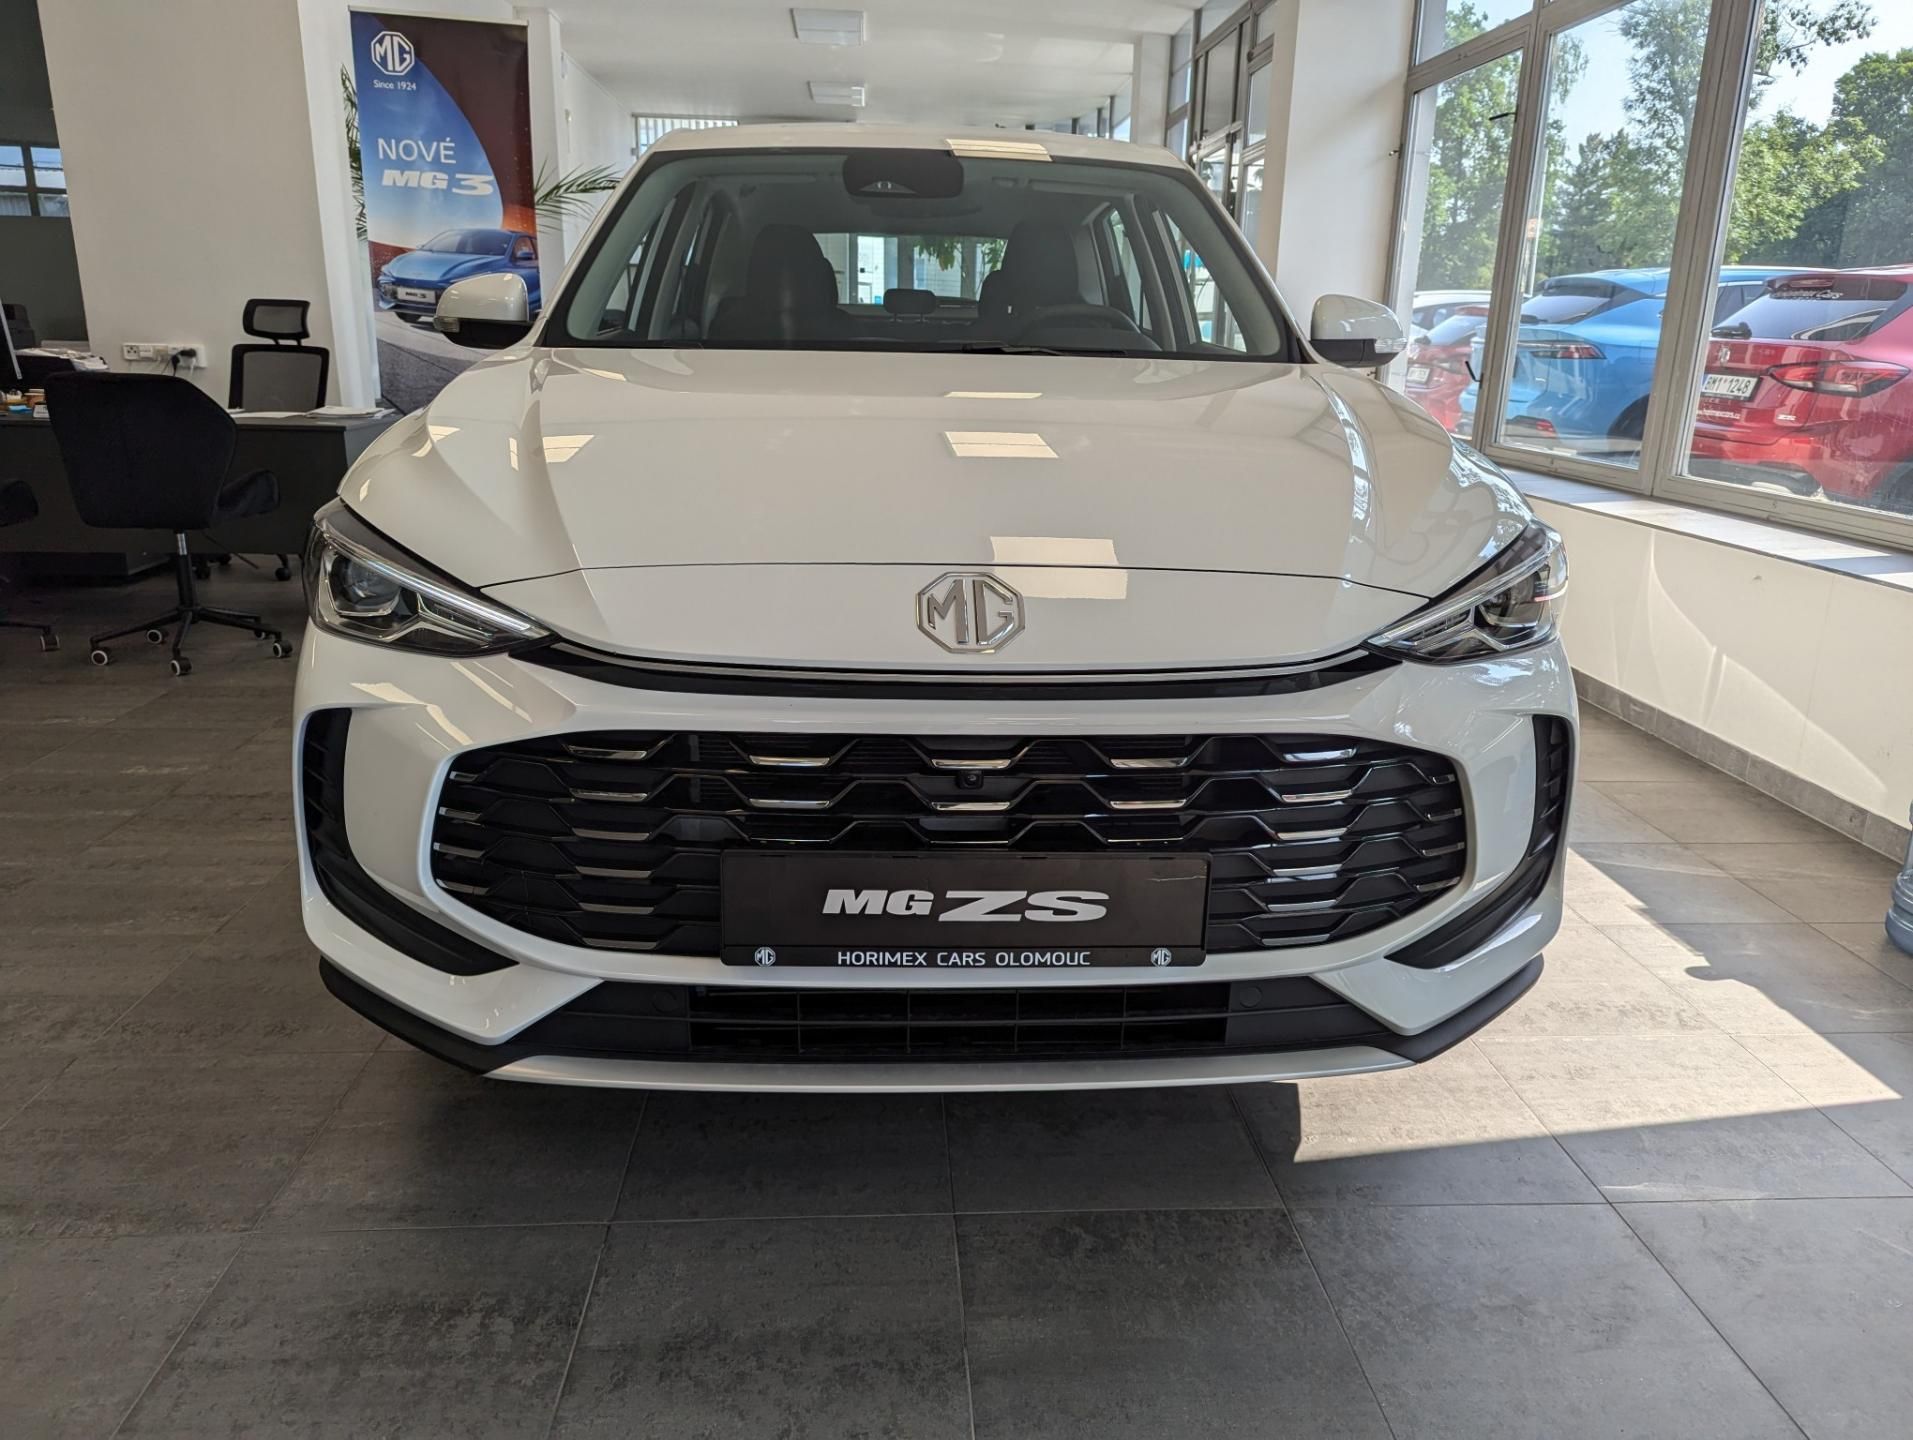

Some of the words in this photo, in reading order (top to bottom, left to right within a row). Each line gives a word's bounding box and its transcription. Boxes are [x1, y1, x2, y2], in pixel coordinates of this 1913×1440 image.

[374, 34, 412, 72] MG
[373, 80, 395, 89] Since
[397, 81, 417, 91] 1924
[377, 137, 457, 165] NOVÉ
[1726, 378, 1751, 394] 1248
[925, 577, 1016, 647] MG
[755, 948, 776, 966] MG
[837, 951, 928, 966] HORIMEX
[937, 951, 986, 967] CARS
[995, 951, 1091, 966] OLOMOUC
[1153, 949, 1170, 966] MG
